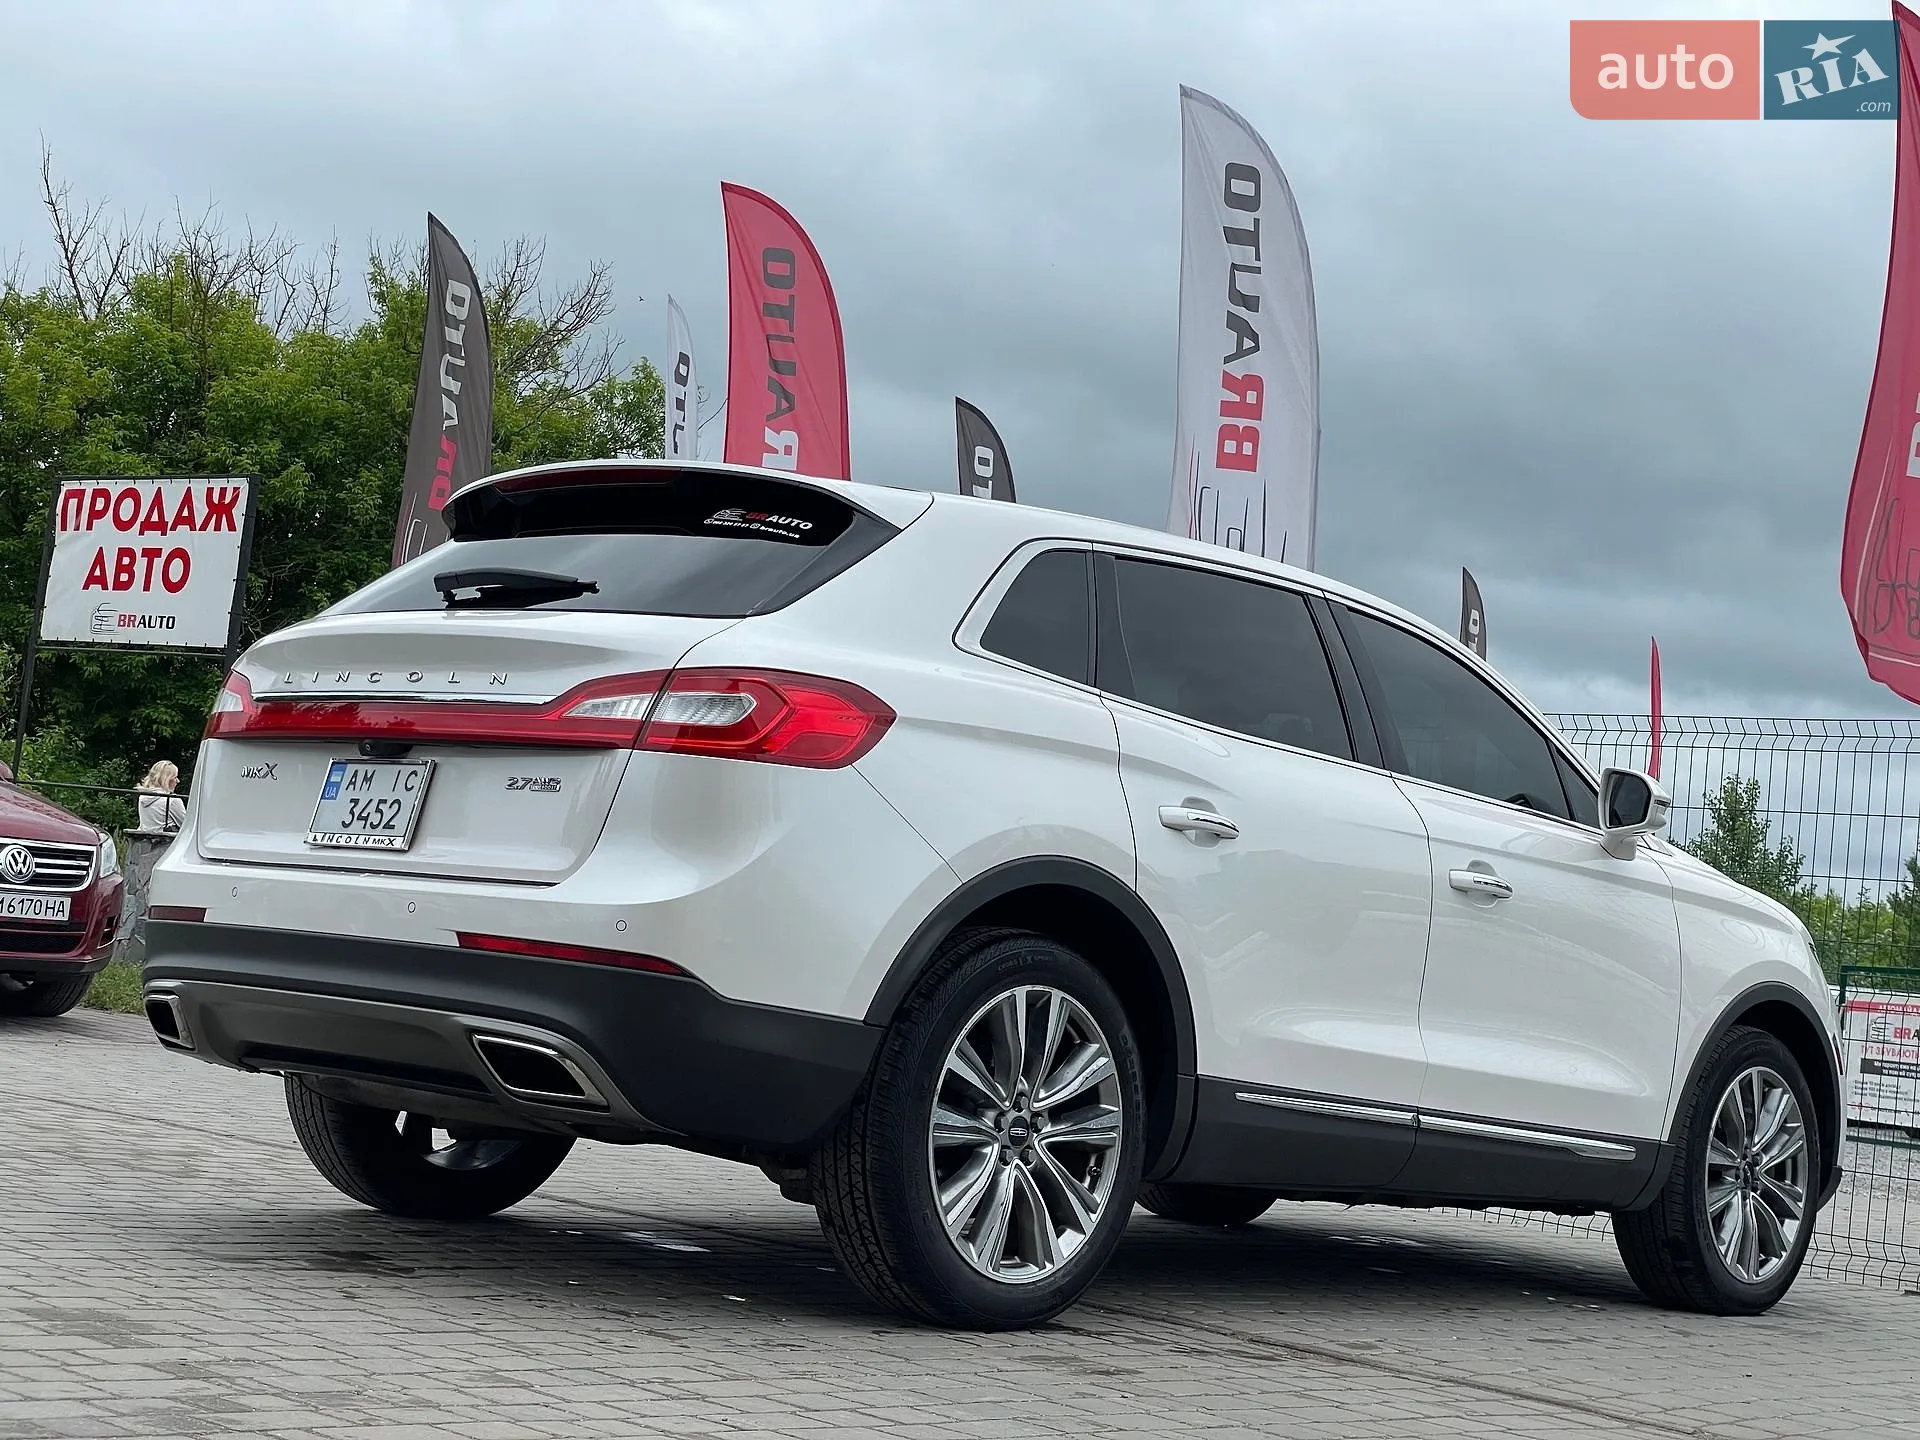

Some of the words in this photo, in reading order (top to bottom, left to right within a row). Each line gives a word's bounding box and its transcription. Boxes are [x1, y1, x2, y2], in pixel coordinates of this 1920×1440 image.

[60, 485, 242, 537] ПРОДАЖ
[745, 512, 813, 530] BRAUTO
[82, 547, 192, 595] АВТО
[117, 613, 176, 631] BRAUTO
[283, 670, 509, 686] LINCOLN
[240, 761, 279, 781] MKX
[345, 768, 377, 792] AM
[325, 785, 337, 798] UA
[341, 797, 402, 830] 3452
